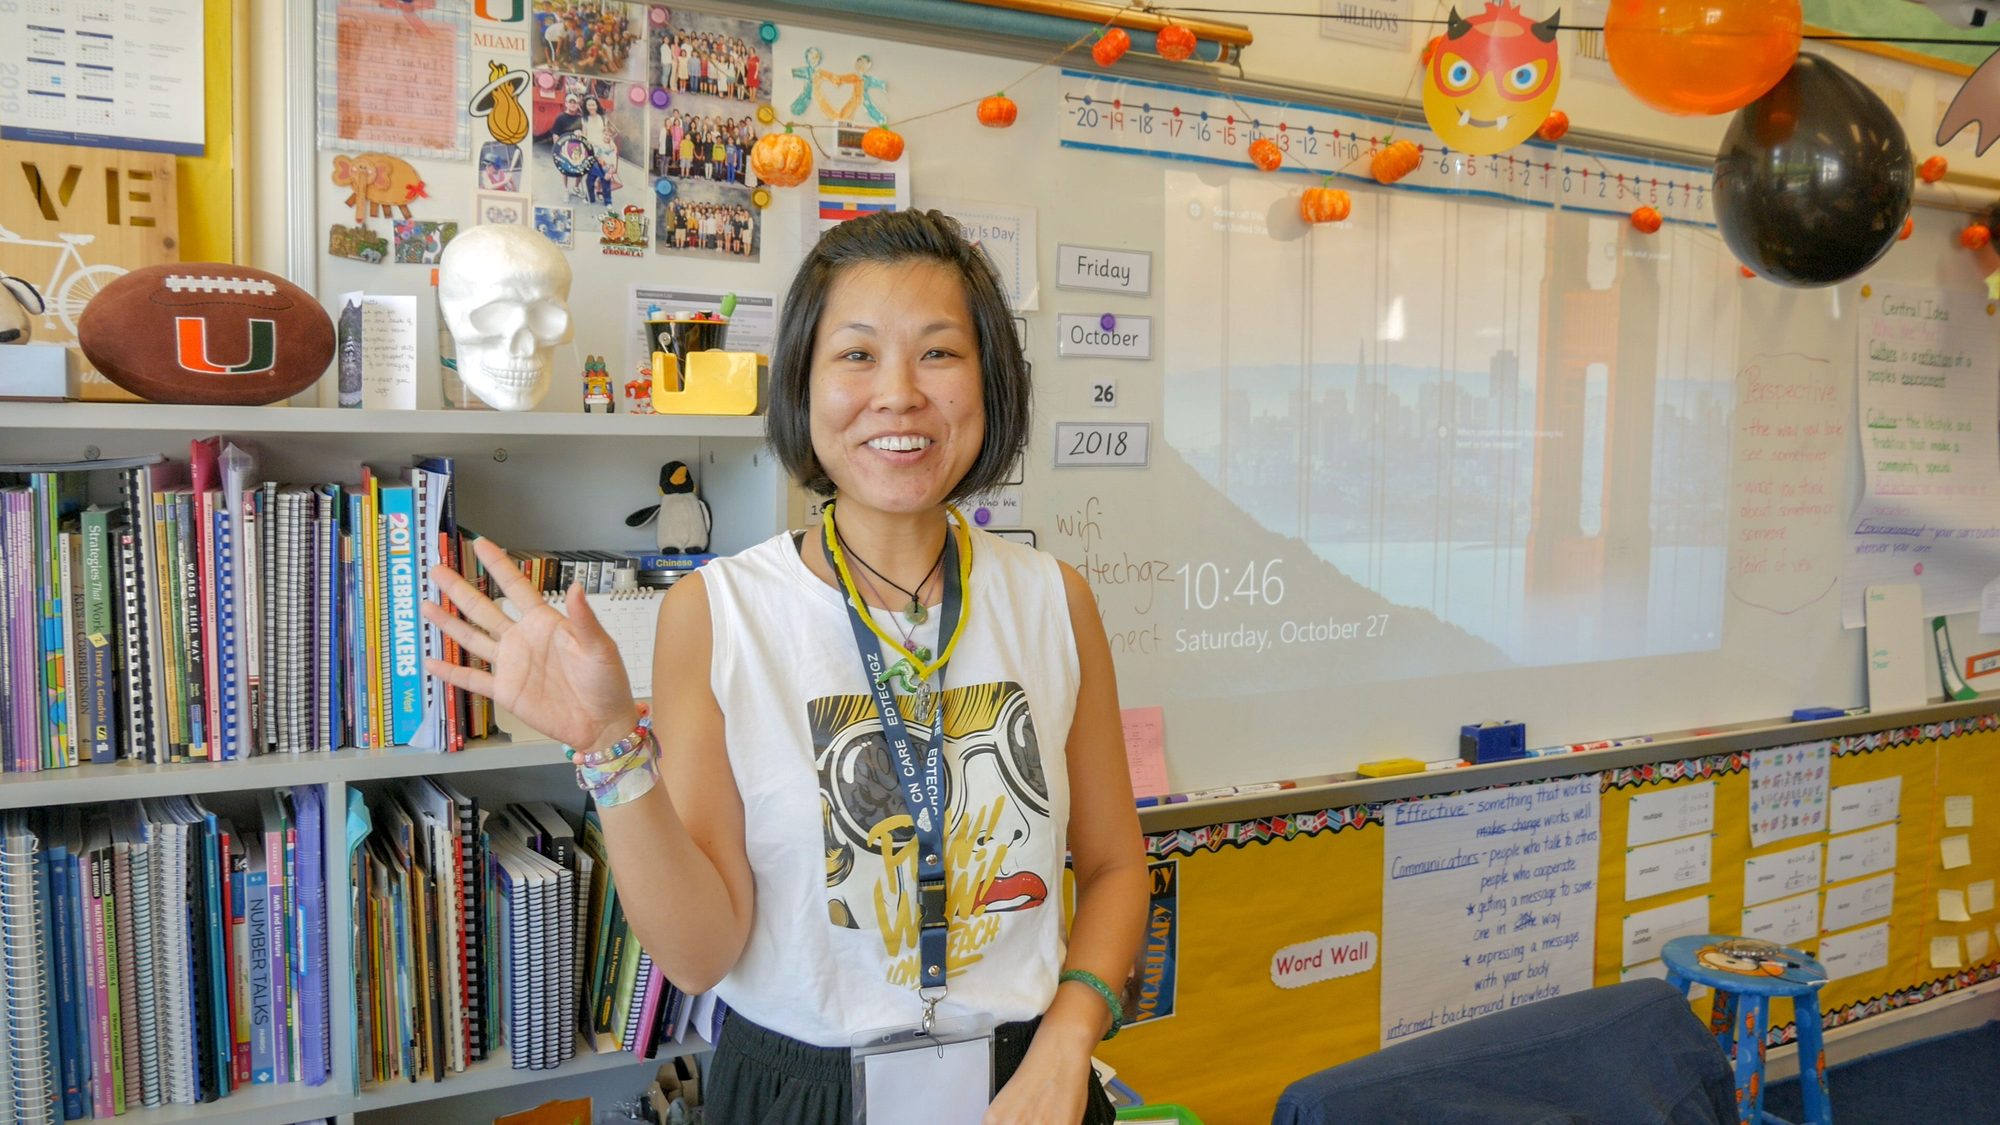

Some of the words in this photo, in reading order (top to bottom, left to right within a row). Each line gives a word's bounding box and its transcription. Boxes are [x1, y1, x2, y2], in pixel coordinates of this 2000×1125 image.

[473, 32, 526, 52] MIAMI
[1069, 107, 1098, 128] -20
[1102, 111, 1124, 131] -19
[1130, 114, 1153, 134] -18
[1162, 118, 1184, 138] -17
[1189, 122, 1211, 141] -16
[1216, 126, 1236, 145] -15
[1296, 136, 1317, 155] -12
[1325, 139, 1342, 157] -11
[1342, 141, 1360, 161] -10
[1433, 157, 1449, 175] -6
[1484, 160, 1498, 178] -4
[1503, 165, 1514, 183] -3
[1519, 168, 1530, 187] -2
[1540, 171, 1548, 188] -1
[1563, 175, 1572, 194] 0
[1599, 180, 1607, 198] 2
[1616, 183, 1625, 200] 3
[1649, 189, 1657, 205] 5
[1666, 192, 1675, 207] 6
[979, 225, 988, 241] Is
[991, 227, 1016, 244] Day
[1077, 255, 1130, 287] Friday
[1882, 295, 1921, 317] Central
[1924, 299, 1949, 321] Idea
[176, 317, 276, 375] U
[1071, 325, 1139, 347] October
[1094, 384, 1115, 402] 26
[1069, 430, 1128, 457] 2018
[978, 499, 998, 507] Who
[1004, 499, 1017, 508] We
[387, 512, 411, 555] 201
[1056, 497, 1103, 551] wifi
[87, 525, 103, 581] Strategies
[655, 558, 693, 568] Chinese
[91, 580, 103, 600] That
[187, 562, 197, 599] WORDS
[1076, 552, 1175, 615] dtechgz
[1175, 558, 1285, 611] 10:46
[74, 594, 85, 618] KEYS
[92, 602, 105, 632] Work
[189, 604, 200, 634] THEIR
[390, 557, 417, 677] ICEBREAKERS
[1175, 623, 1272, 653] Saturday,
[1280, 617, 1361, 644] October
[1366, 613, 1389, 638] 27
[93, 650, 105, 679] Harvey
[191, 639, 201, 663] WAY
[76, 631, 89, 716] COMPREHENSION
[96, 689, 107, 723] Goudvis
[402, 688, 416, 713] West
[896, 739, 920, 779] CARE
[911, 781, 925, 804] CN
[1477, 792, 1534, 812] something
[1537, 785, 1560, 803] that
[1563, 781, 1592, 798] works
[1543, 810, 1570, 827] works
[1573, 803, 1592, 820] well
[1488, 843, 1520, 868] people
[1523, 836, 1541, 855] who
[1543, 833, 1562, 851] talk
[1565, 831, 1573, 847] to
[92, 861, 101, 876] VELS
[103, 859, 111, 874] VELS
[1479, 869, 1510, 893] people
[1513, 864, 1531, 881] who
[1533, 858, 1577, 880] cooperate
[92, 876, 102, 899] EDITION
[104, 874, 112, 895] EDITION
[94, 904, 103, 925] MATHS
[106, 902, 114, 924] MATHS
[272, 894, 282, 911] Math
[1477, 894, 1507, 920] getting
[1511, 895, 1518, 907] a
[1520, 886, 1557, 906] message
[1562, 880, 1571, 897] to
[274, 911, 283, 925] and
[1496, 922, 1506, 936] in
[1541, 911, 1562, 929] way
[95, 925, 104, 942] PLUS
[107, 925, 115, 941] PLUS
[249, 899, 268, 969] NUMBER
[274, 926, 284, 957] Literature
[96, 943, 104, 956] FOR
[1135, 902, 1173, 1022] VOCABULARY
[1275, 948, 1323, 977] Word
[1330, 941, 1369, 966] Wall
[1476, 943, 1526, 968] expressing
[1530, 942, 1538, 953] a
[1541, 930, 1580, 950] message
[97, 956, 105, 983] VICTORIA
[1474, 972, 1498, 991] with
[1502, 968, 1523, 989] your
[1527, 962, 1550, 982] body
[252, 973, 270, 1026] TALKS
[1440, 995, 1505, 1027] background
[1509, 983, 1561, 1009] knowledge
